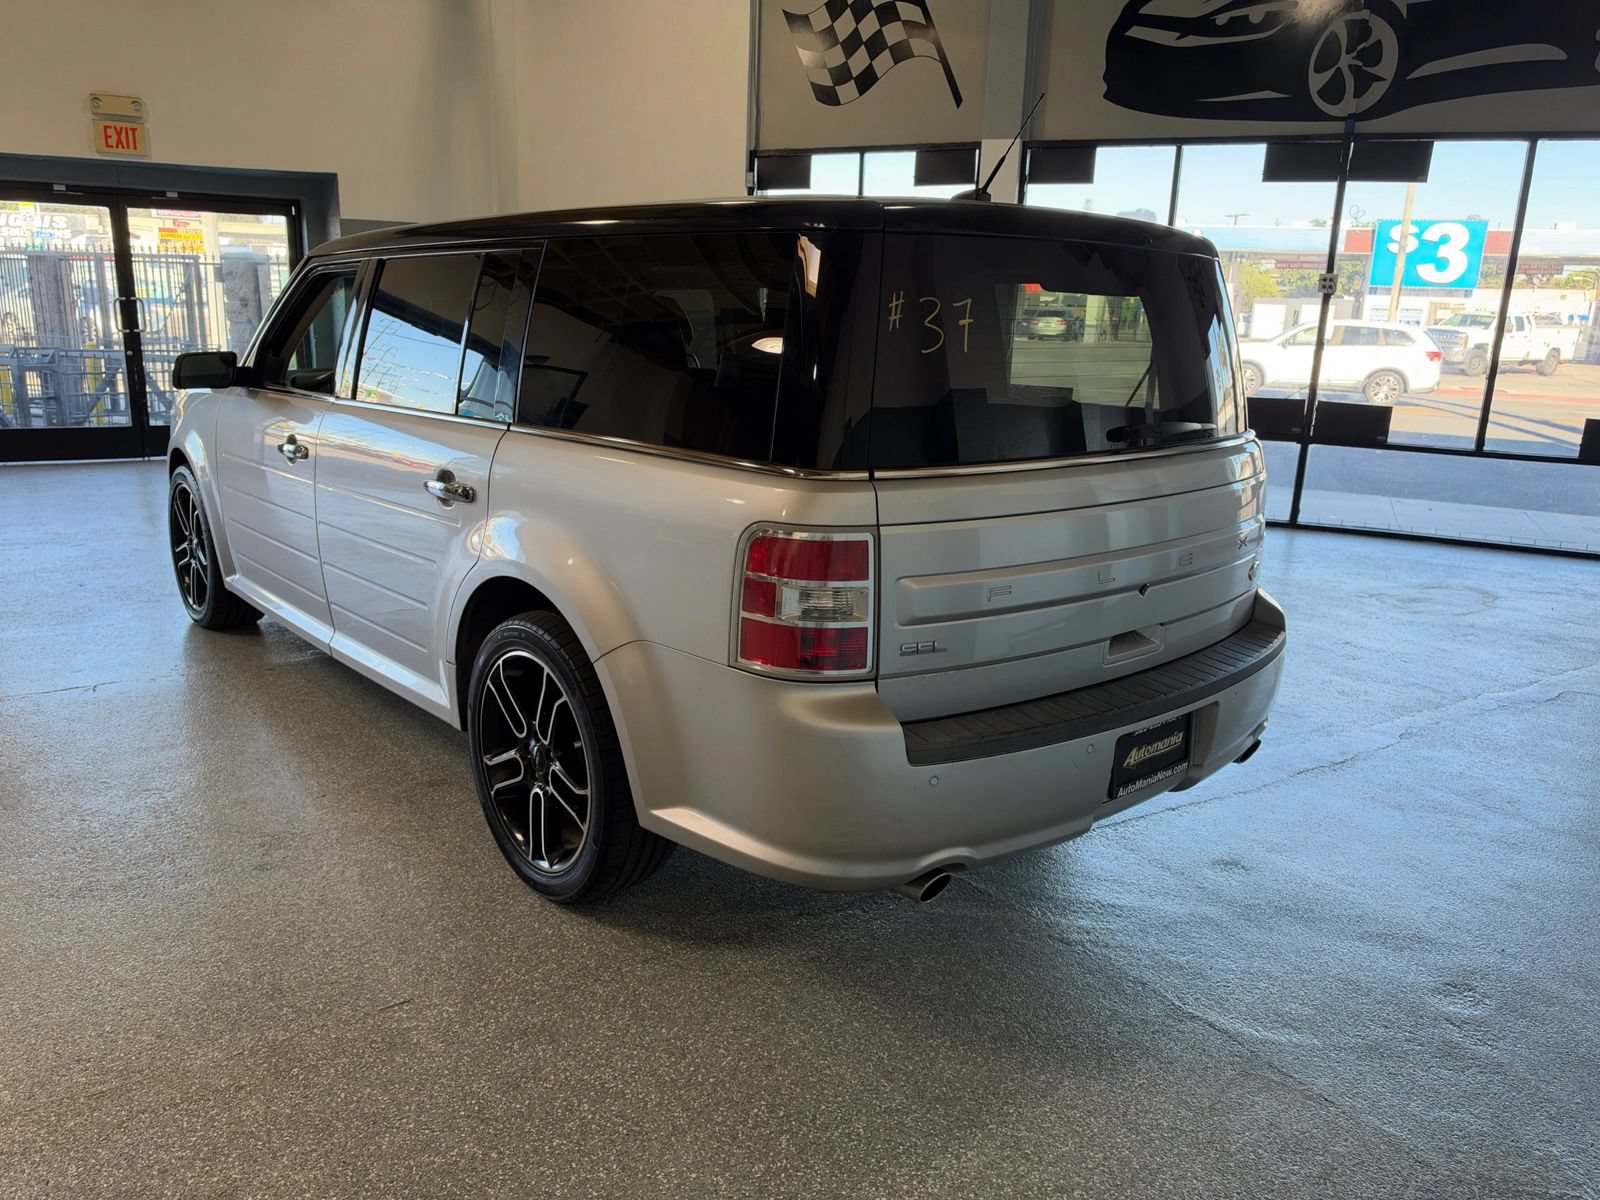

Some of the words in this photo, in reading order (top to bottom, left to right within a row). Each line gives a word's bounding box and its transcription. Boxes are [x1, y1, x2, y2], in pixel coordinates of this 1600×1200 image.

[103, 125, 138, 151] EXIT
[899, 640, 948, 656] SEL
[1123, 731, 1184, 769] Automania
[1117, 761, 1188, 798] AutoManiaNow.com
